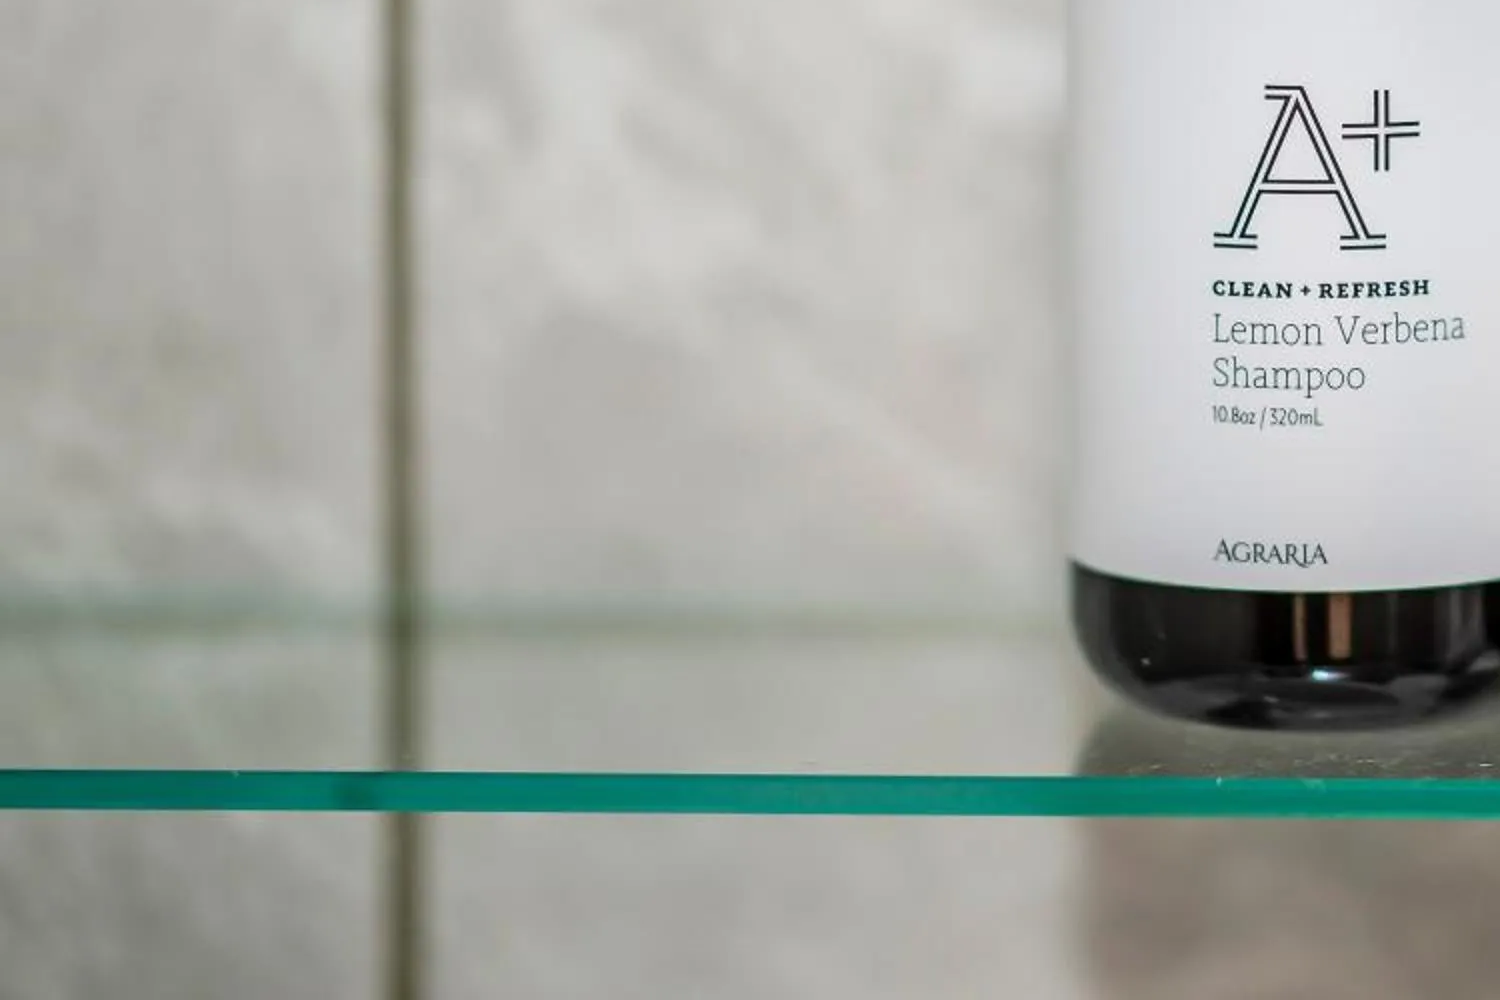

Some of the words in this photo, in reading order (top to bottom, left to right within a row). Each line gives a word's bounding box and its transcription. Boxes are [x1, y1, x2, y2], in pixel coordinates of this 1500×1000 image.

[1212, 279, 1292, 299] CLEAN
[1318, 279, 1430, 299] REFRESH
[1212, 313, 1323, 347] Lemon
[1333, 311, 1466, 345] Verbena
[1212, 356, 1367, 399] Shampoo
[1212, 405, 1256, 426] 10.8oz
[1269, 407, 1324, 427] 320mL
[1213, 539, 1329, 569] AGRARIA
